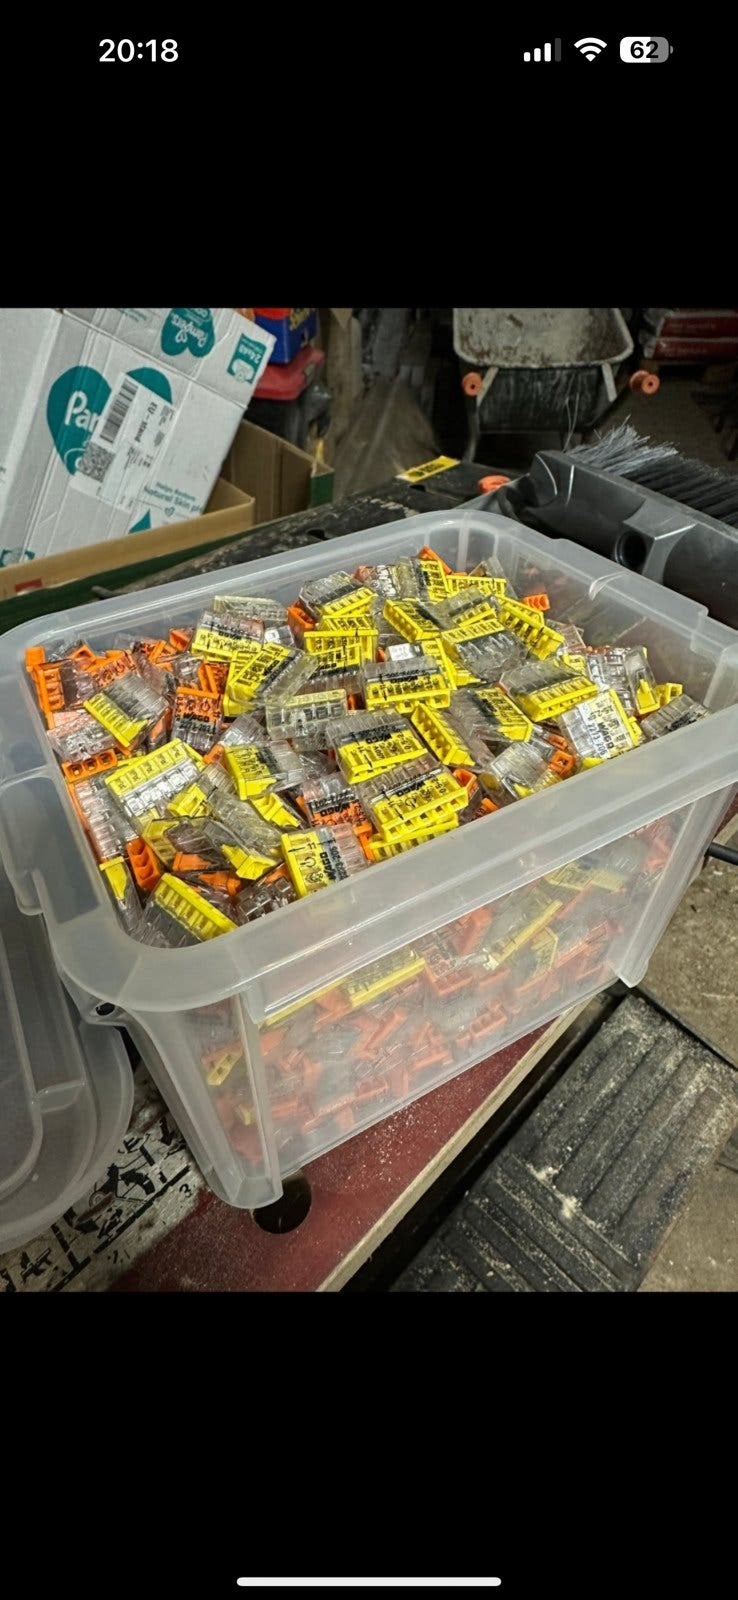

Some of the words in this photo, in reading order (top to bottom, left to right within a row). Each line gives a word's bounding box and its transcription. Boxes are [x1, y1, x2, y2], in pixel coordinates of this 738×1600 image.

[170, 313, 209, 349] Pampers
[147, 401, 158, 416] EU
[183, 712, 210, 723] WAGO
[365, 733, 393, 745] WAGO
[598, 721, 615, 749] WAGO
[397, 782, 426, 797] WAGO
[319, 802, 350, 817] WAGO
[319, 852, 337, 881] WAGO
